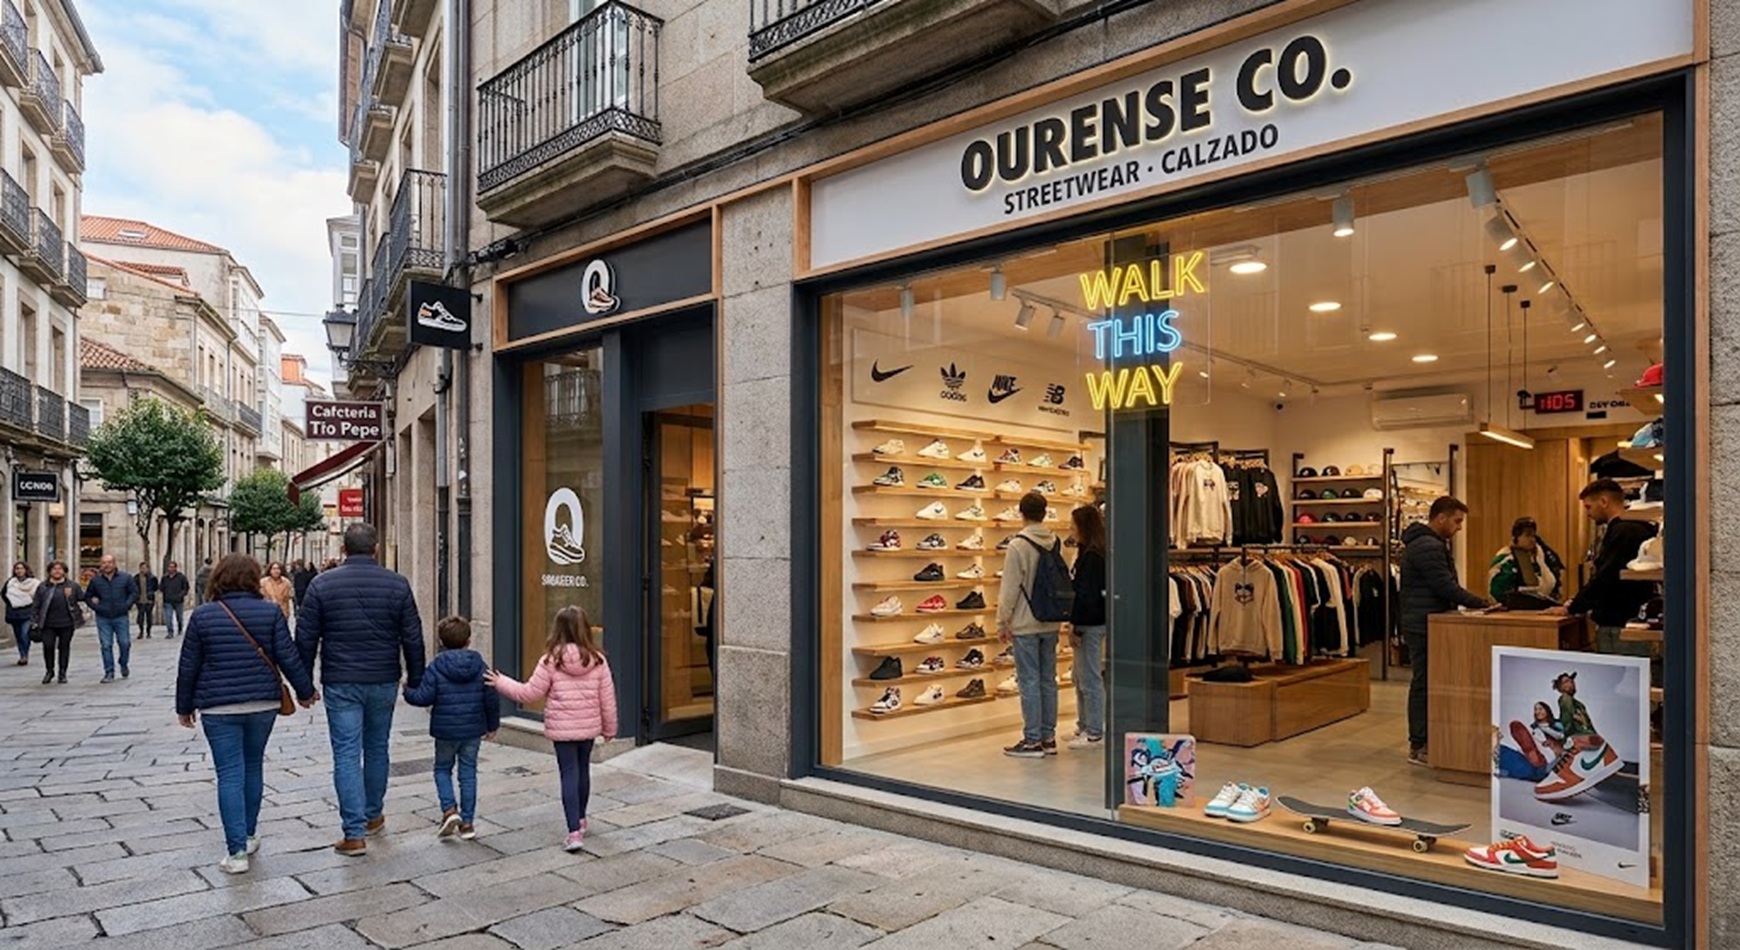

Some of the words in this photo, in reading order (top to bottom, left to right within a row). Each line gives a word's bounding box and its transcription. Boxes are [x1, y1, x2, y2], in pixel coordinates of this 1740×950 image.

[961, 68, 1211, 191] OURENSE
[1236, 35, 1352, 111] CO.
[1004, 160, 1140, 214] STREETWEAR
[1161, 123, 1279, 174] CALZADO
[1079, 251, 1205, 311] WALK
[1087, 310, 1182, 360] THIS
[1085, 361, 1184, 411] WAY
[341, 421, 380, 439] Pepe
